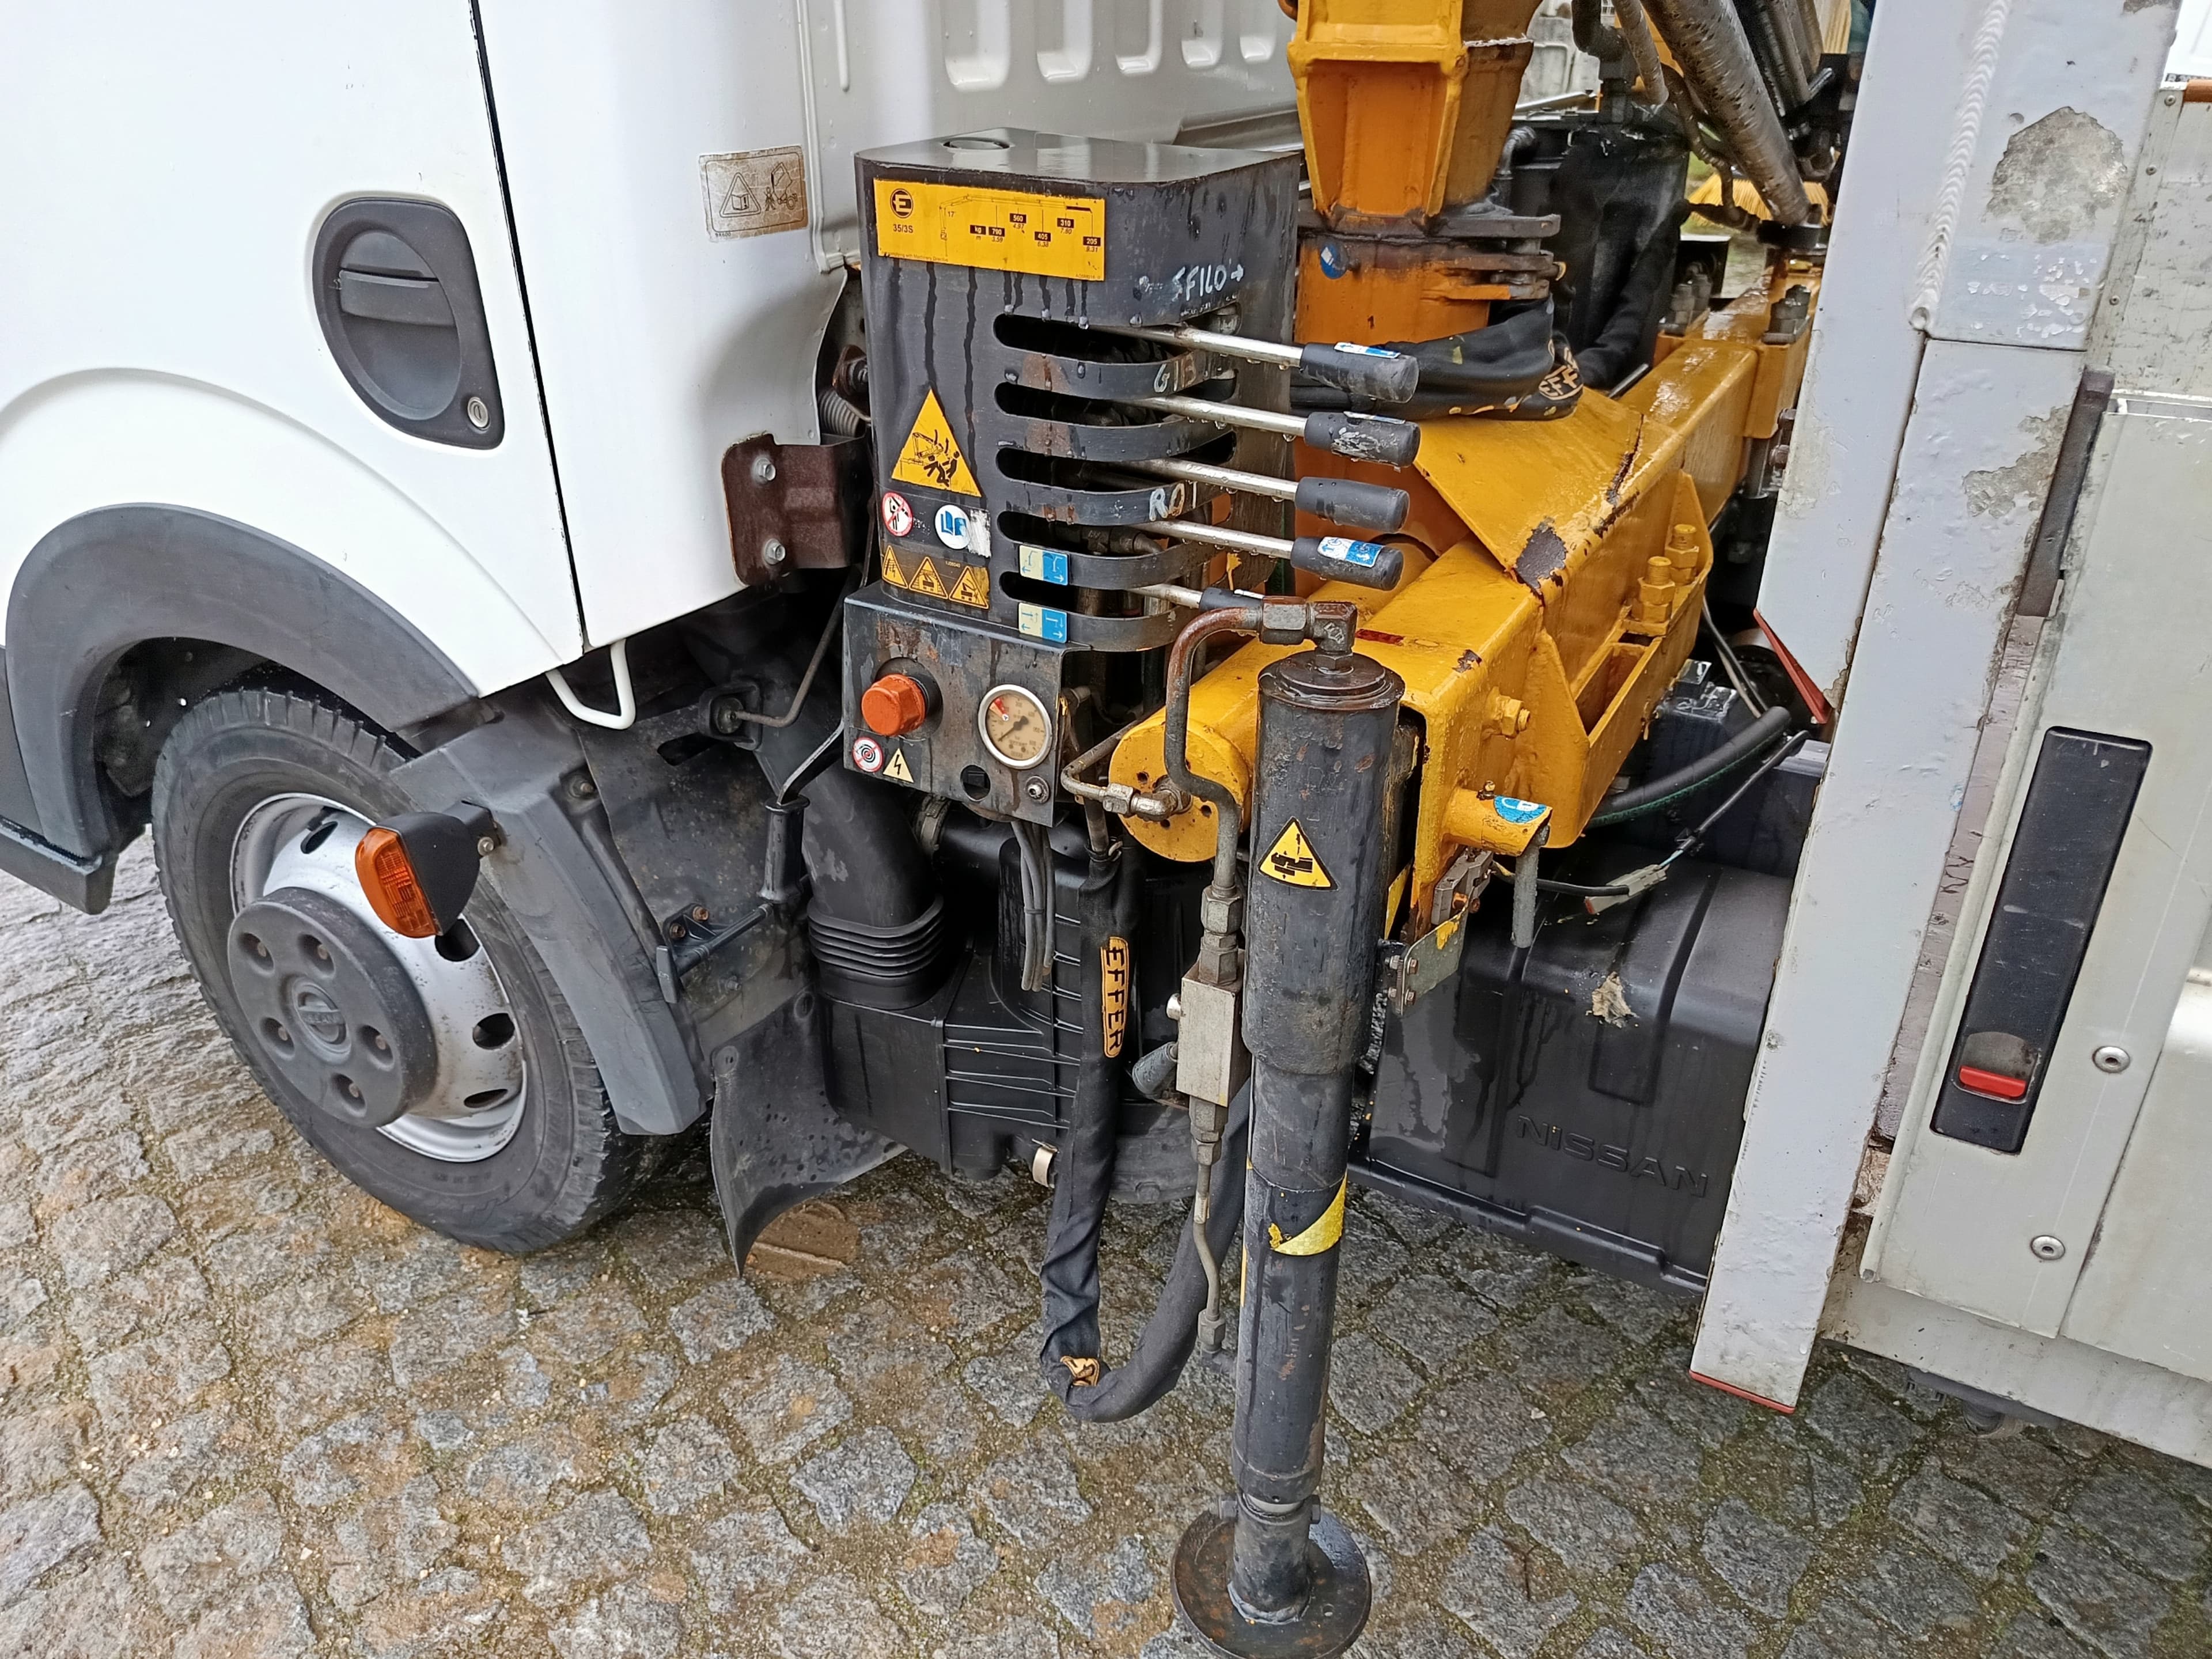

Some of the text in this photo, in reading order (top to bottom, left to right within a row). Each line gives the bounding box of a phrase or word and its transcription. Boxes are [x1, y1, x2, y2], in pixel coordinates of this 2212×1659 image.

[893, 224, 914, 233] 35/3S
[1060, 219, 1071, 227] 310
[1105, 946, 1125, 1051] EFFER
[1516, 1115, 1708, 1198] NISSAN
